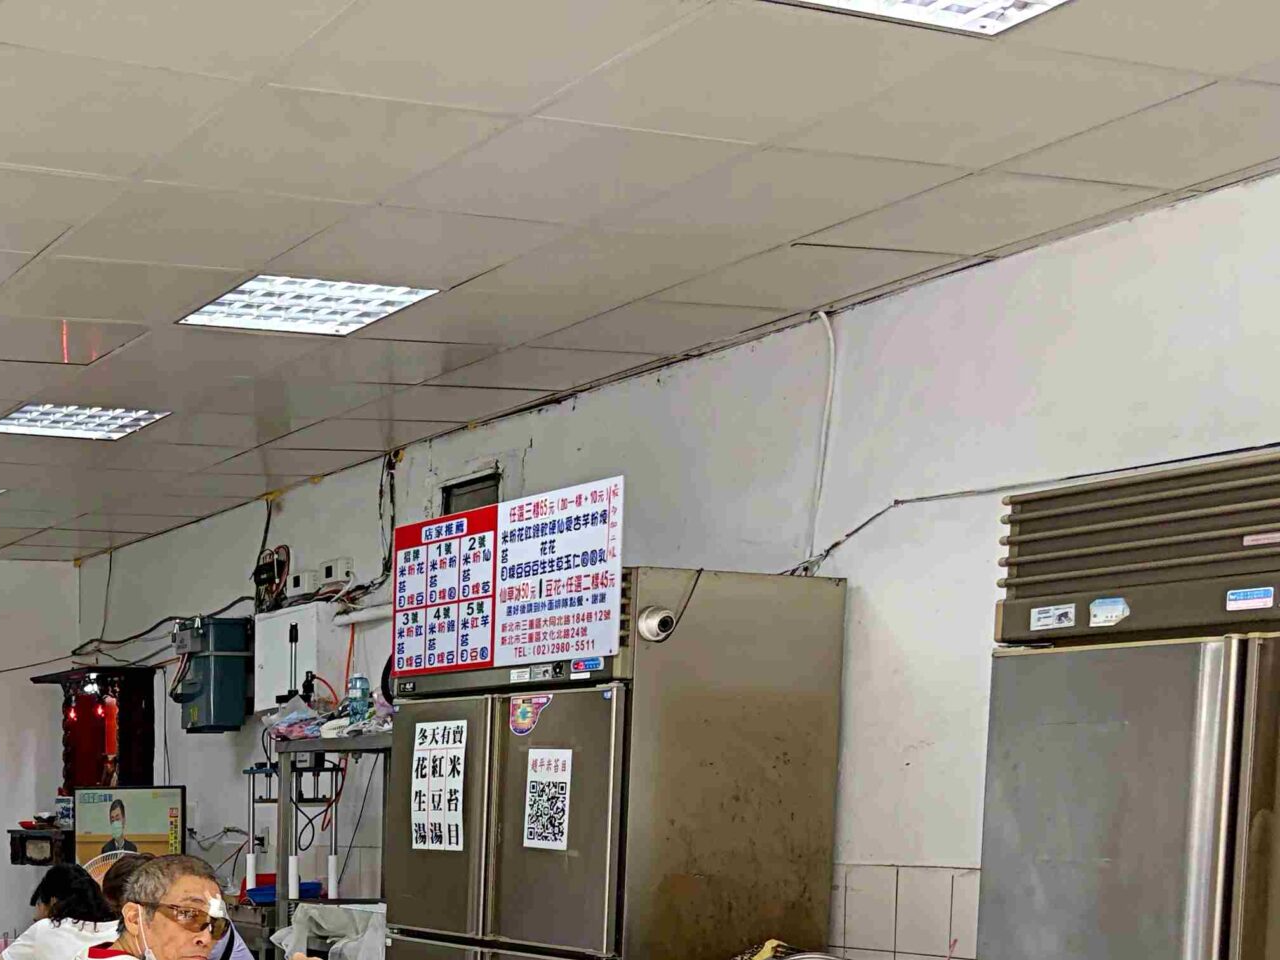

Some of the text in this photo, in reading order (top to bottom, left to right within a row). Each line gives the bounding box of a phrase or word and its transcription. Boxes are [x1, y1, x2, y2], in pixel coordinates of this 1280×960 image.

[424, 518, 464, 541] 店家推薦
[418, 725, 464, 746] 冬天有賣
[414, 756, 427, 845] 花生湯
[430, 755, 444, 845] 紅豆湯
[447, 755, 461, 846] 米苔目
